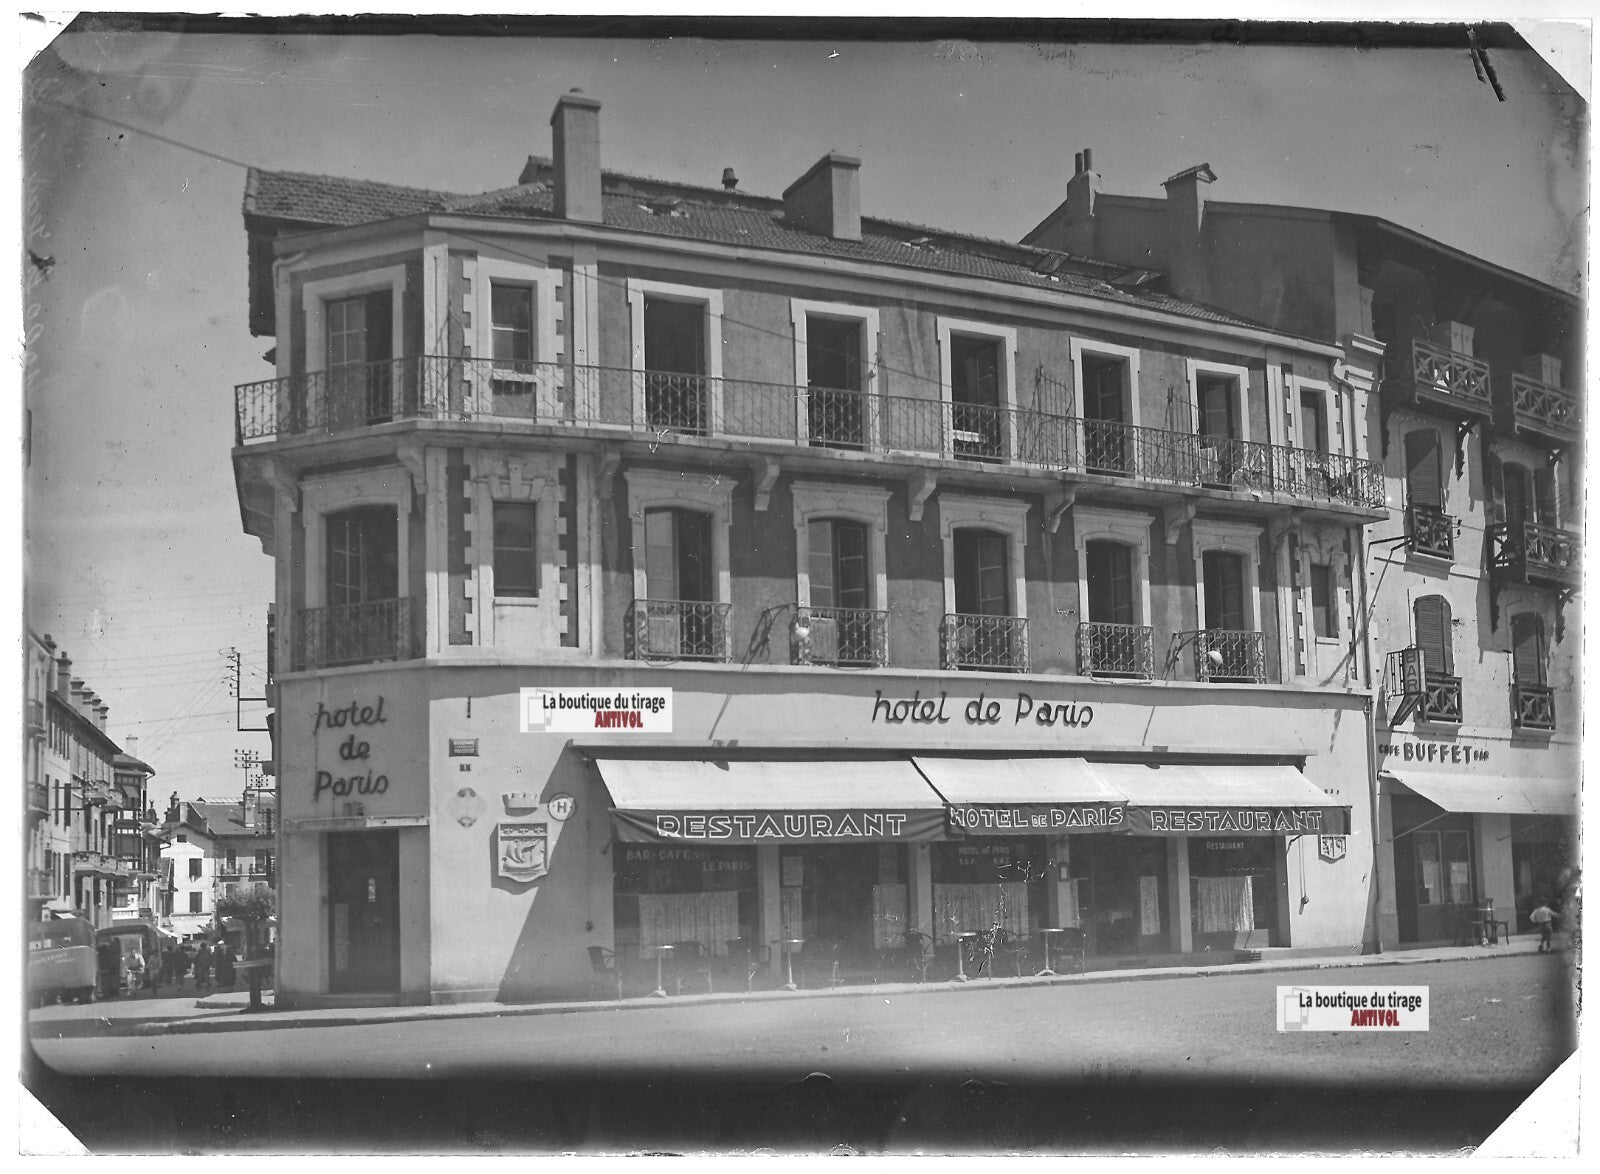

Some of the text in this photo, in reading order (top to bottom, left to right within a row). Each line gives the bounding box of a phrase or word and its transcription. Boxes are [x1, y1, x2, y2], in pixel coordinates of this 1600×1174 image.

[1406, 650, 1418, 691] BAR
[312, 696, 387, 735] hotel
[872, 690, 1094, 728] hotel de Paris
[339, 734, 370, 760] de
[1403, 742, 1472, 764] BUFFET
[313, 769, 388, 802] Paris
[557, 801, 567, 813] H
[950, 807, 1124, 828] HOTEL DE PARIS
[656, 814, 907, 839] RESTAURANT
[1151, 810, 1323, 831] RESTAURANT
